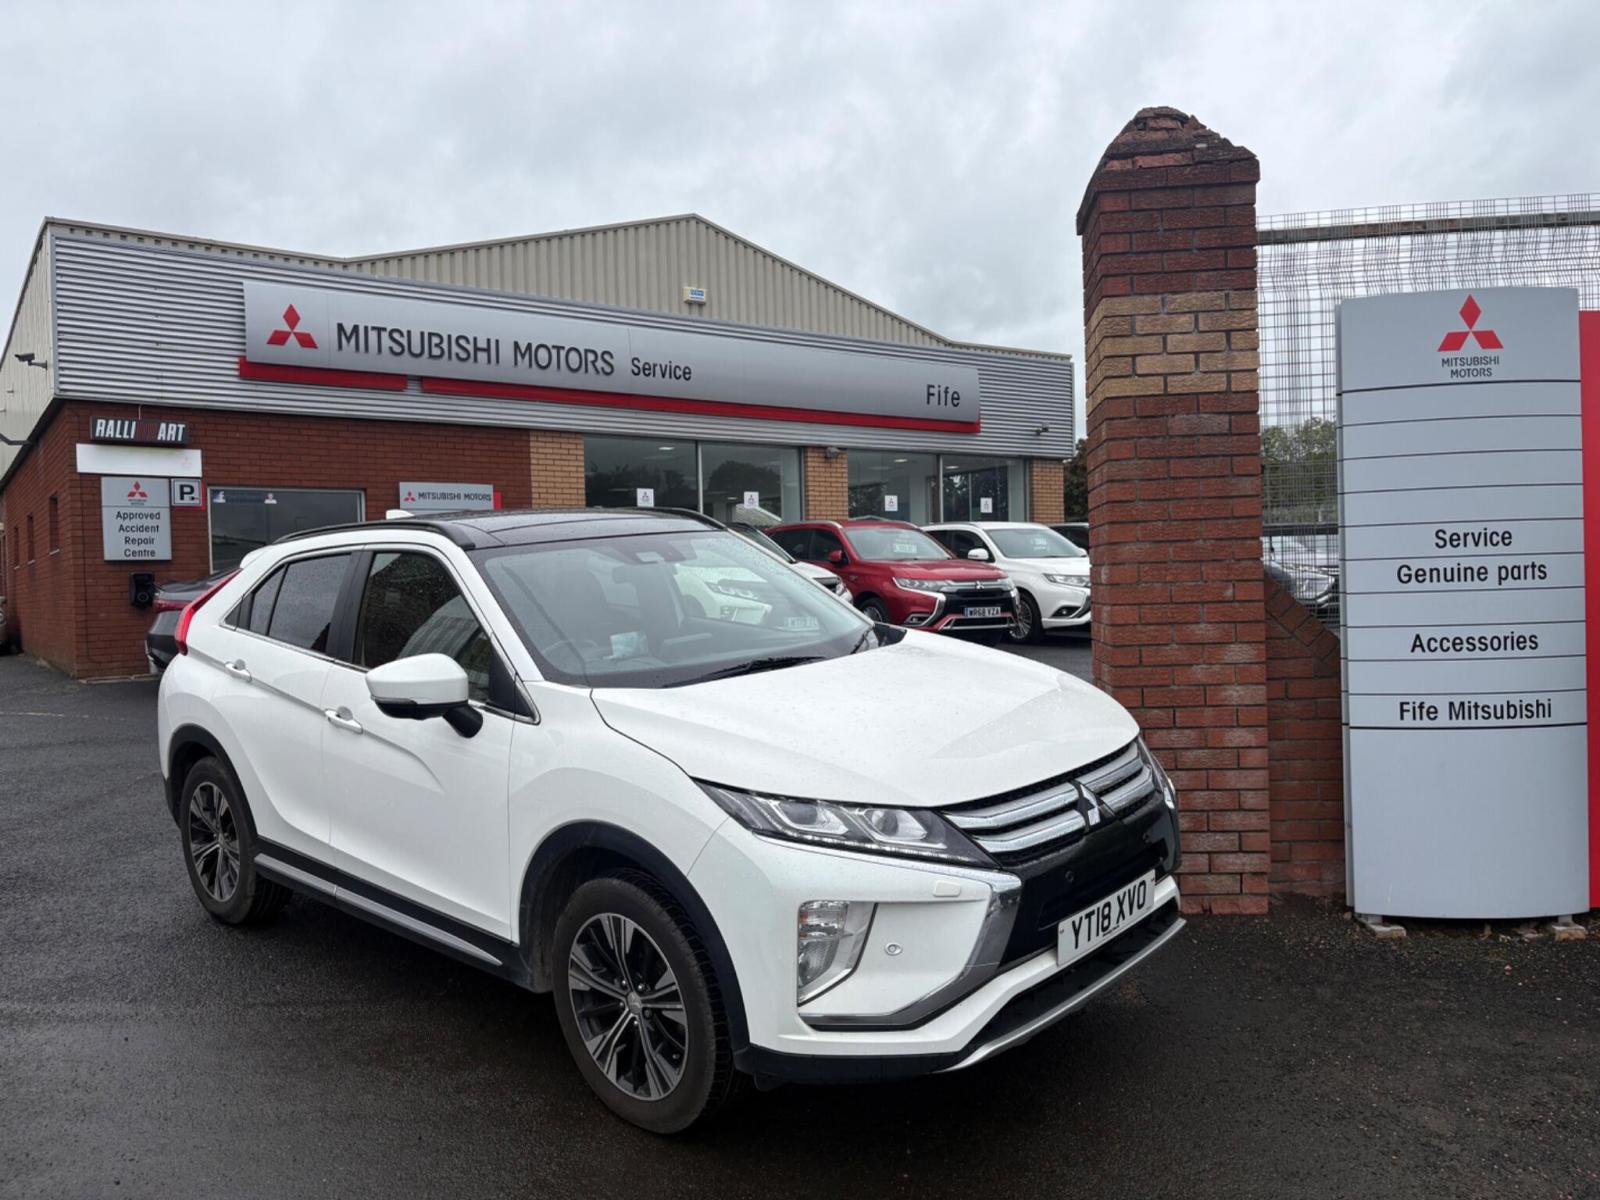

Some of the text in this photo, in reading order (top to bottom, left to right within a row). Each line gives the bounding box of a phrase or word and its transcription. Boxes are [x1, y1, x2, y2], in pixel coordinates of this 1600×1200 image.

[337, 322, 692, 381] MITSUBISHI MOTORS Service
[1441, 355, 1500, 368] MITSUBISHI
[1450, 367, 1493, 379] MOTORS
[926, 384, 961, 407] Fife
[95, 419, 185, 441] RALLI ART
[418, 491, 492, 502] MITSUBISHI MOTORS
[116, 511, 161, 521] Approved
[118, 524, 160, 533] Accident
[1434, 527, 1513, 549] Service
[124, 536, 155, 547] Repair
[124, 548, 156, 558] Centre
[1396, 561, 1548, 586] Genuine parts
[1410, 631, 1539, 653] Accessories
[1399, 698, 1552, 721] Fife Mitsubishi
[1071, 880, 1147, 949] YT18 XVO
